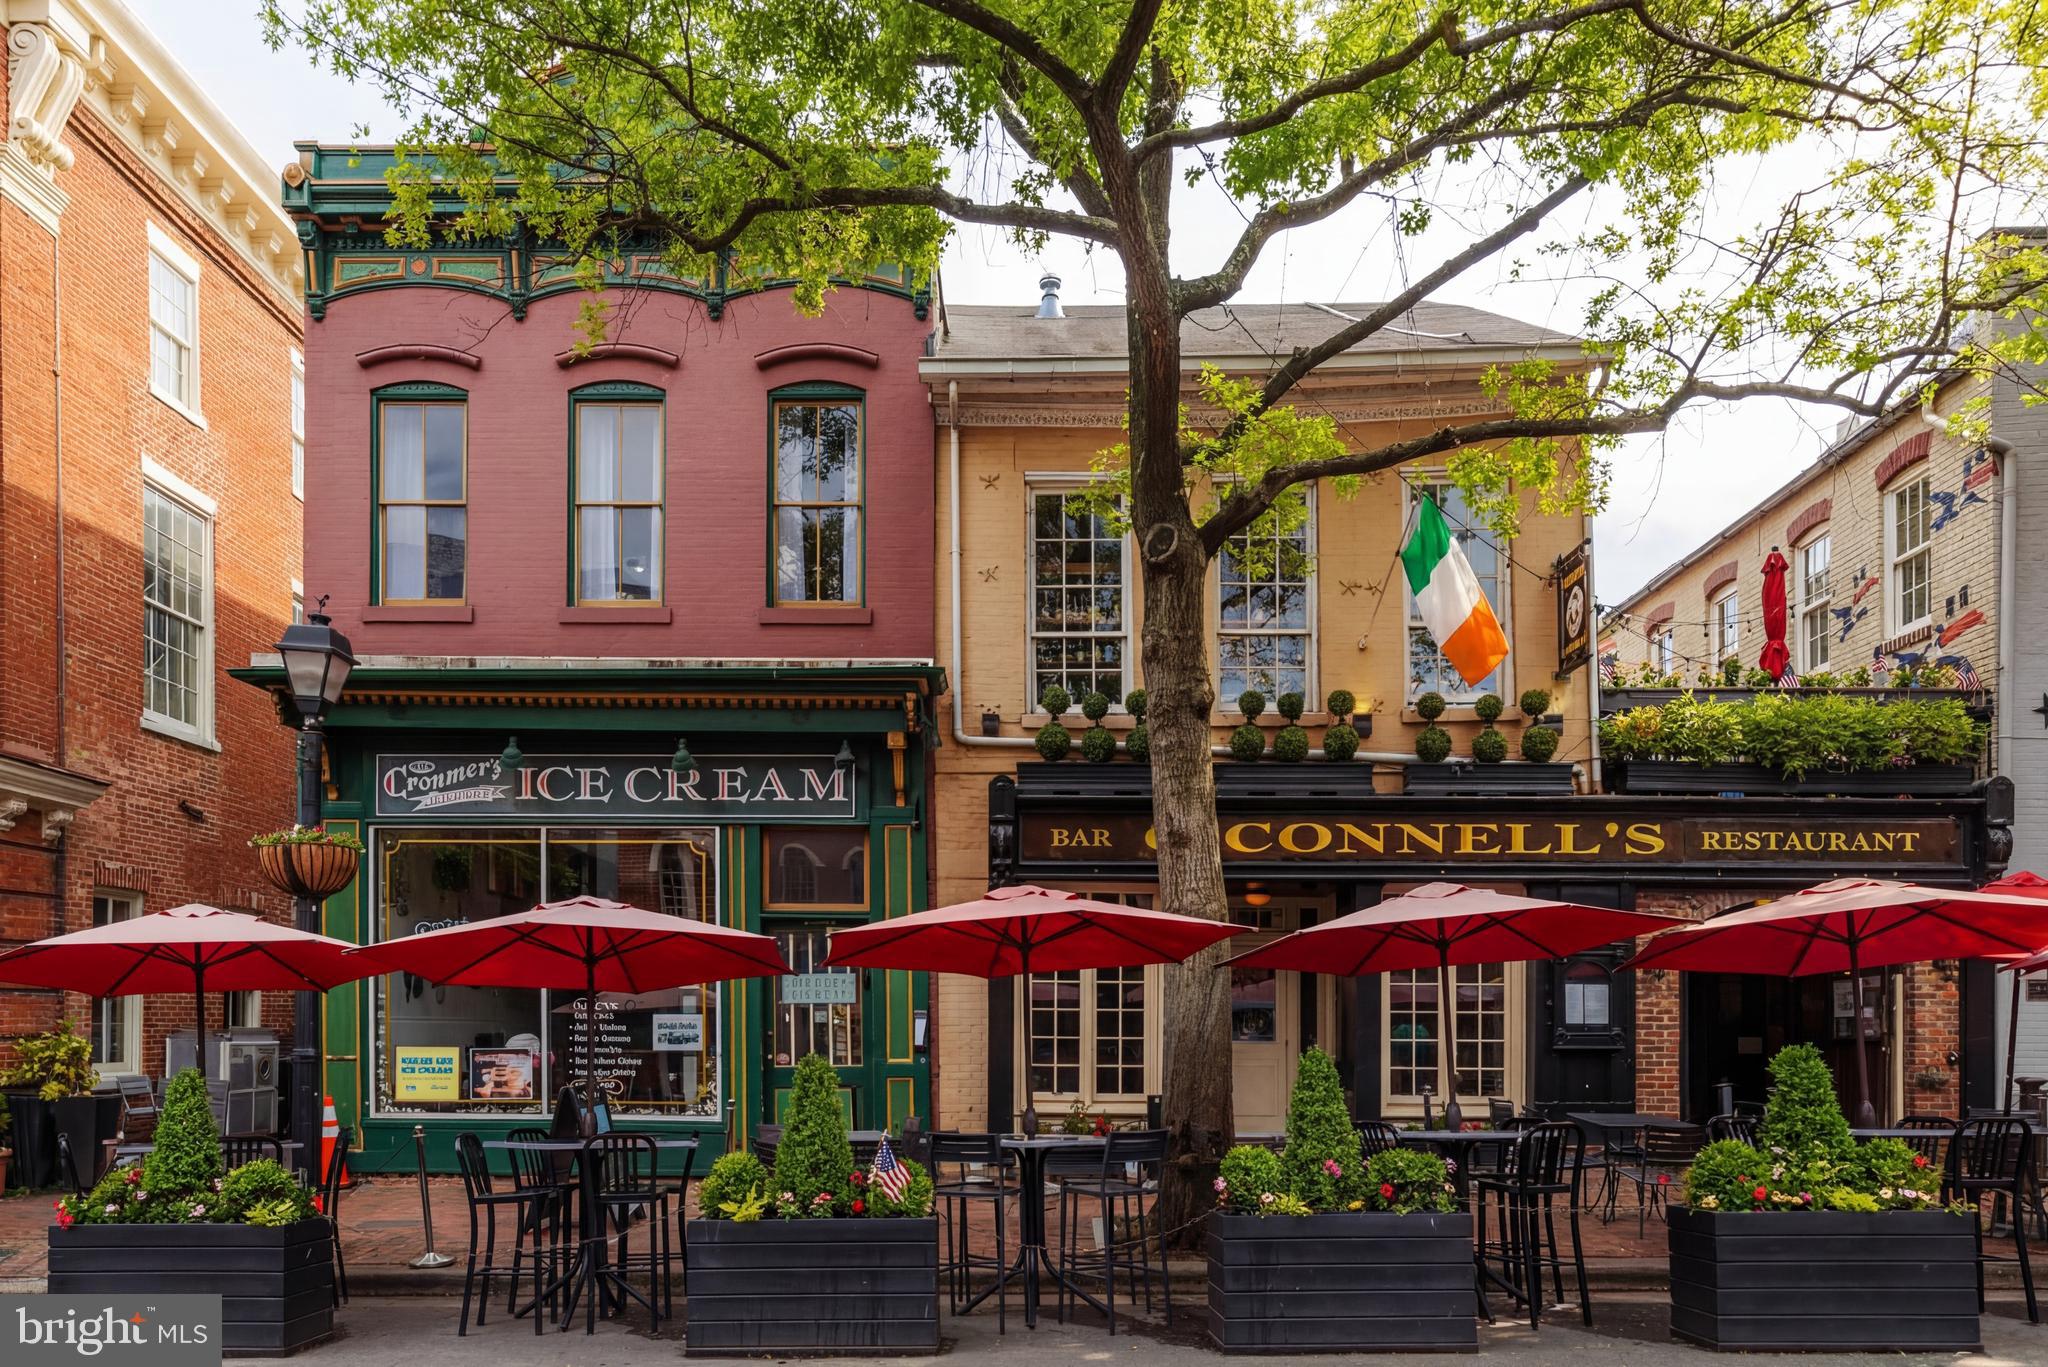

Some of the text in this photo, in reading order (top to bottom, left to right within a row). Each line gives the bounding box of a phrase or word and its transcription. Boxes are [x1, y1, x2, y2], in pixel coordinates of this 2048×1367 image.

[515, 765, 613, 803] ICE
[624, 765, 849, 804] CREAM
[1050, 822, 1665, 852] BAR CONNELL'S
[1702, 831, 1920, 852] RESTAURANT
